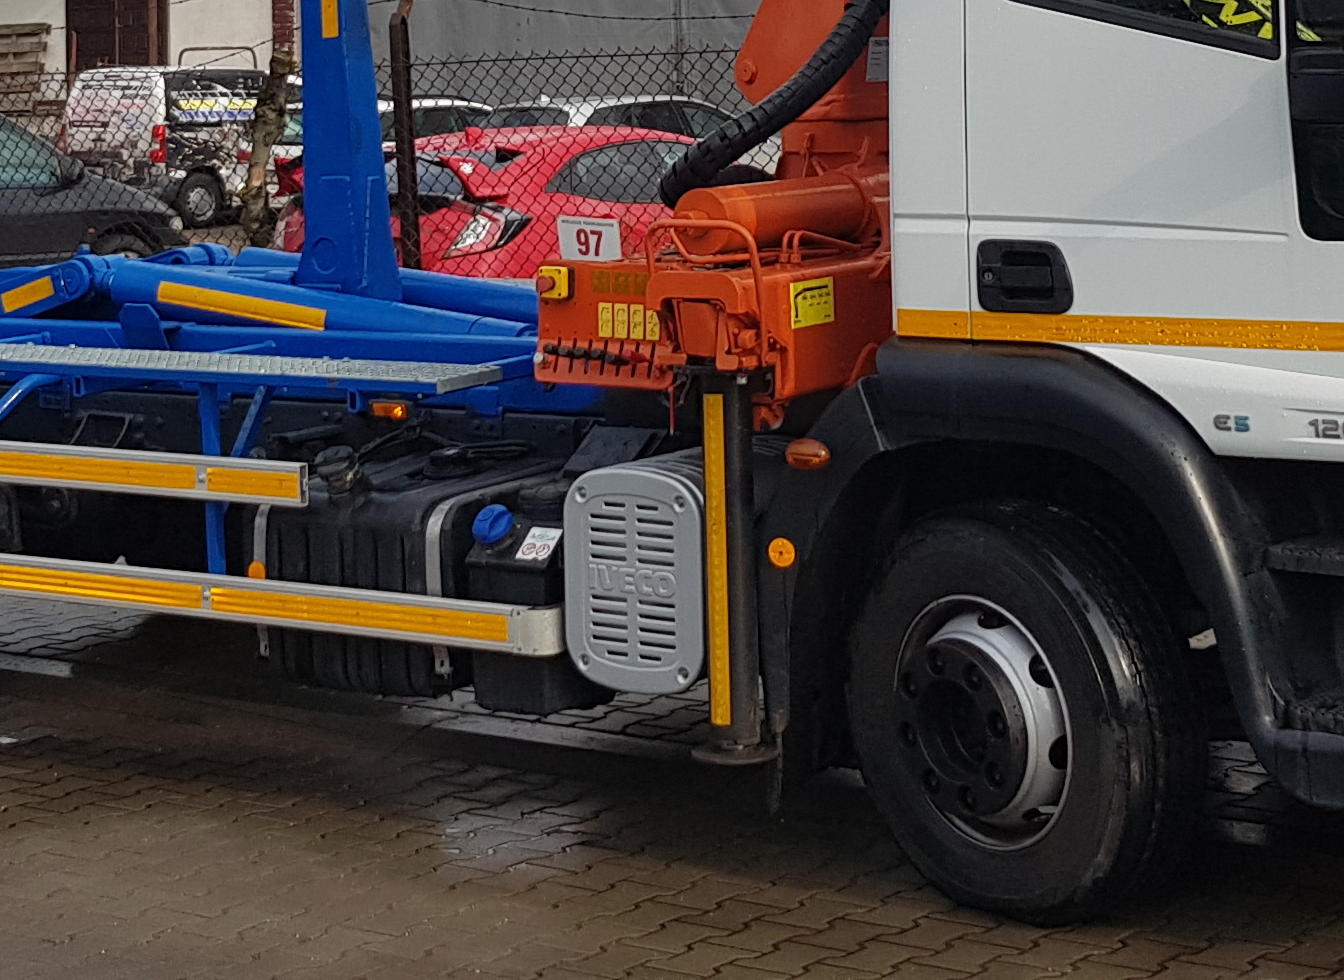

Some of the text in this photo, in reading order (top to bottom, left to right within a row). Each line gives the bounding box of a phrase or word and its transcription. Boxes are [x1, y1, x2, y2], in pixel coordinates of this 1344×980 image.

[576, 228, 603, 257] 97
[1213, 414, 1250, 433] E5
[588, 563, 677, 599] IVECO
